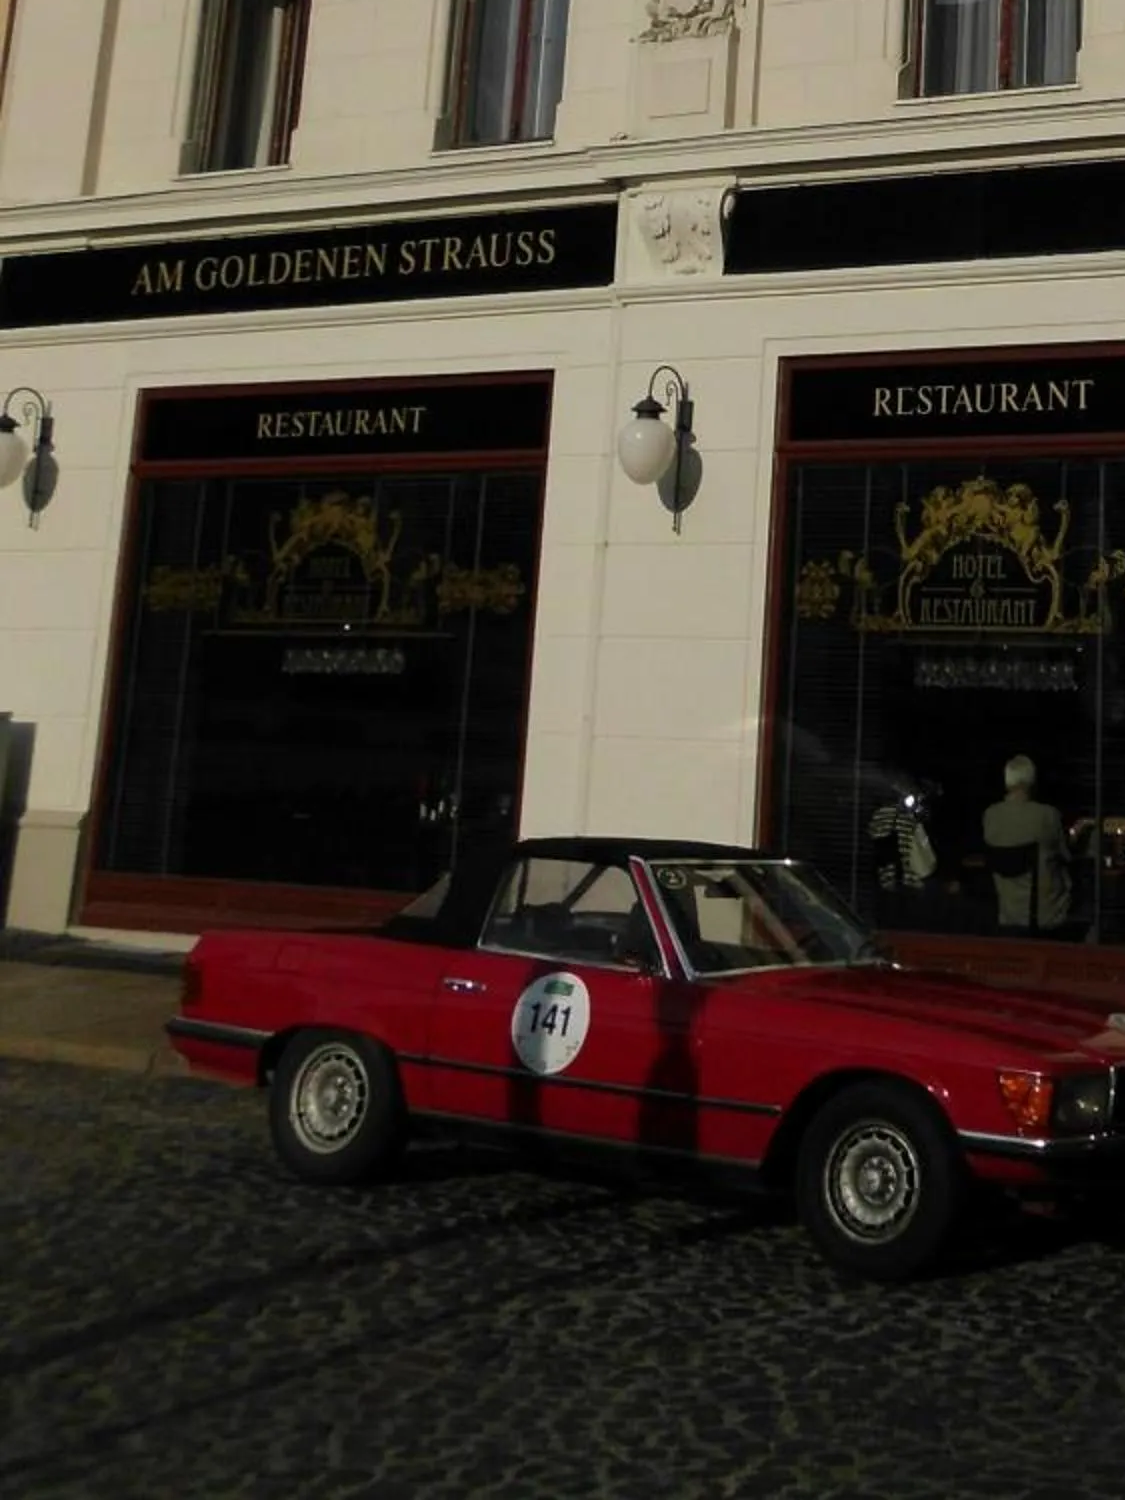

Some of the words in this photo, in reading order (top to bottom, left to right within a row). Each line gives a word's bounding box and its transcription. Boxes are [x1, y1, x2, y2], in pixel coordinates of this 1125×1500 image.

[131, 259, 186, 296] AM
[194, 243, 389, 291] GOLDENEN
[399, 229, 557, 276] STRAUSS
[872, 378, 1096, 418] RESTAURANT
[256, 406, 428, 440] RESTAURANT
[952, 553, 1008, 580] HOTEL
[919, 597, 1039, 626] RESTAURANT
[530, 1002, 572, 1037] 141
